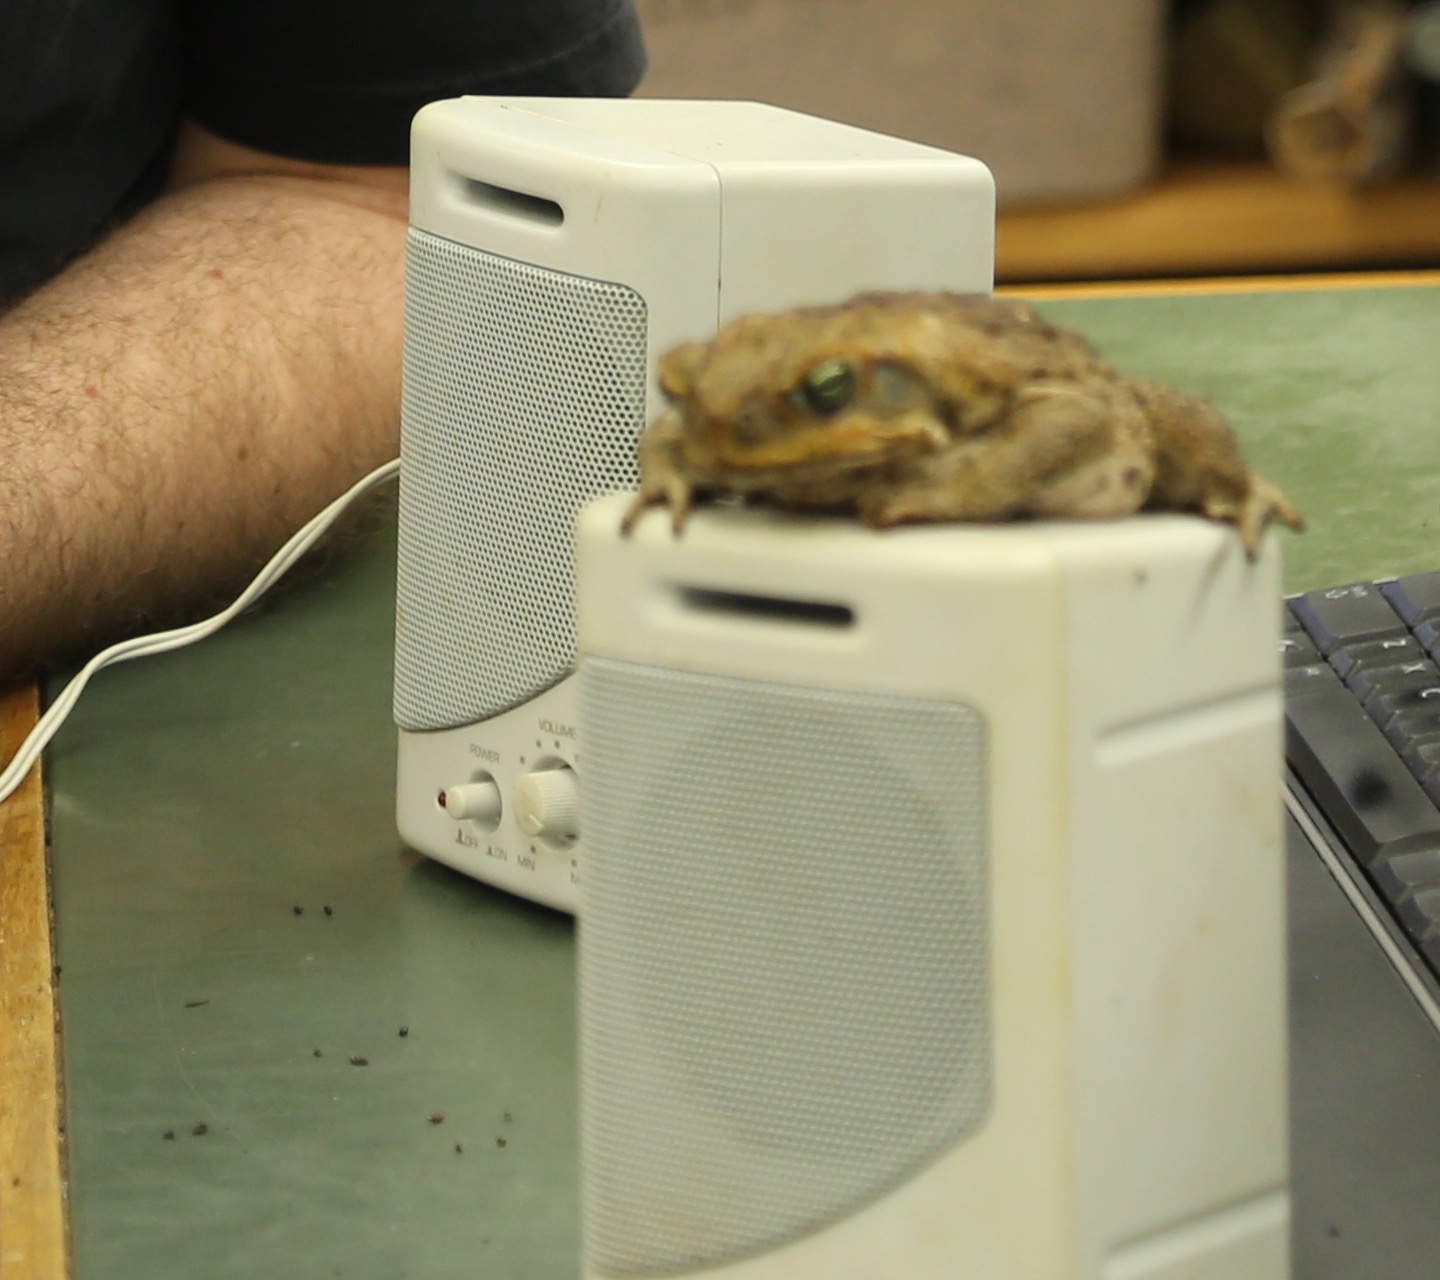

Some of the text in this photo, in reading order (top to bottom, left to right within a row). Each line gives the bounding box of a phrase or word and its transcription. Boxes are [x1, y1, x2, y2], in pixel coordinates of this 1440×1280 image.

[538, 719, 576, 738] VOLUME
[469, 743, 500, 764] POWER
[517, 855, 535, 871] MIN
